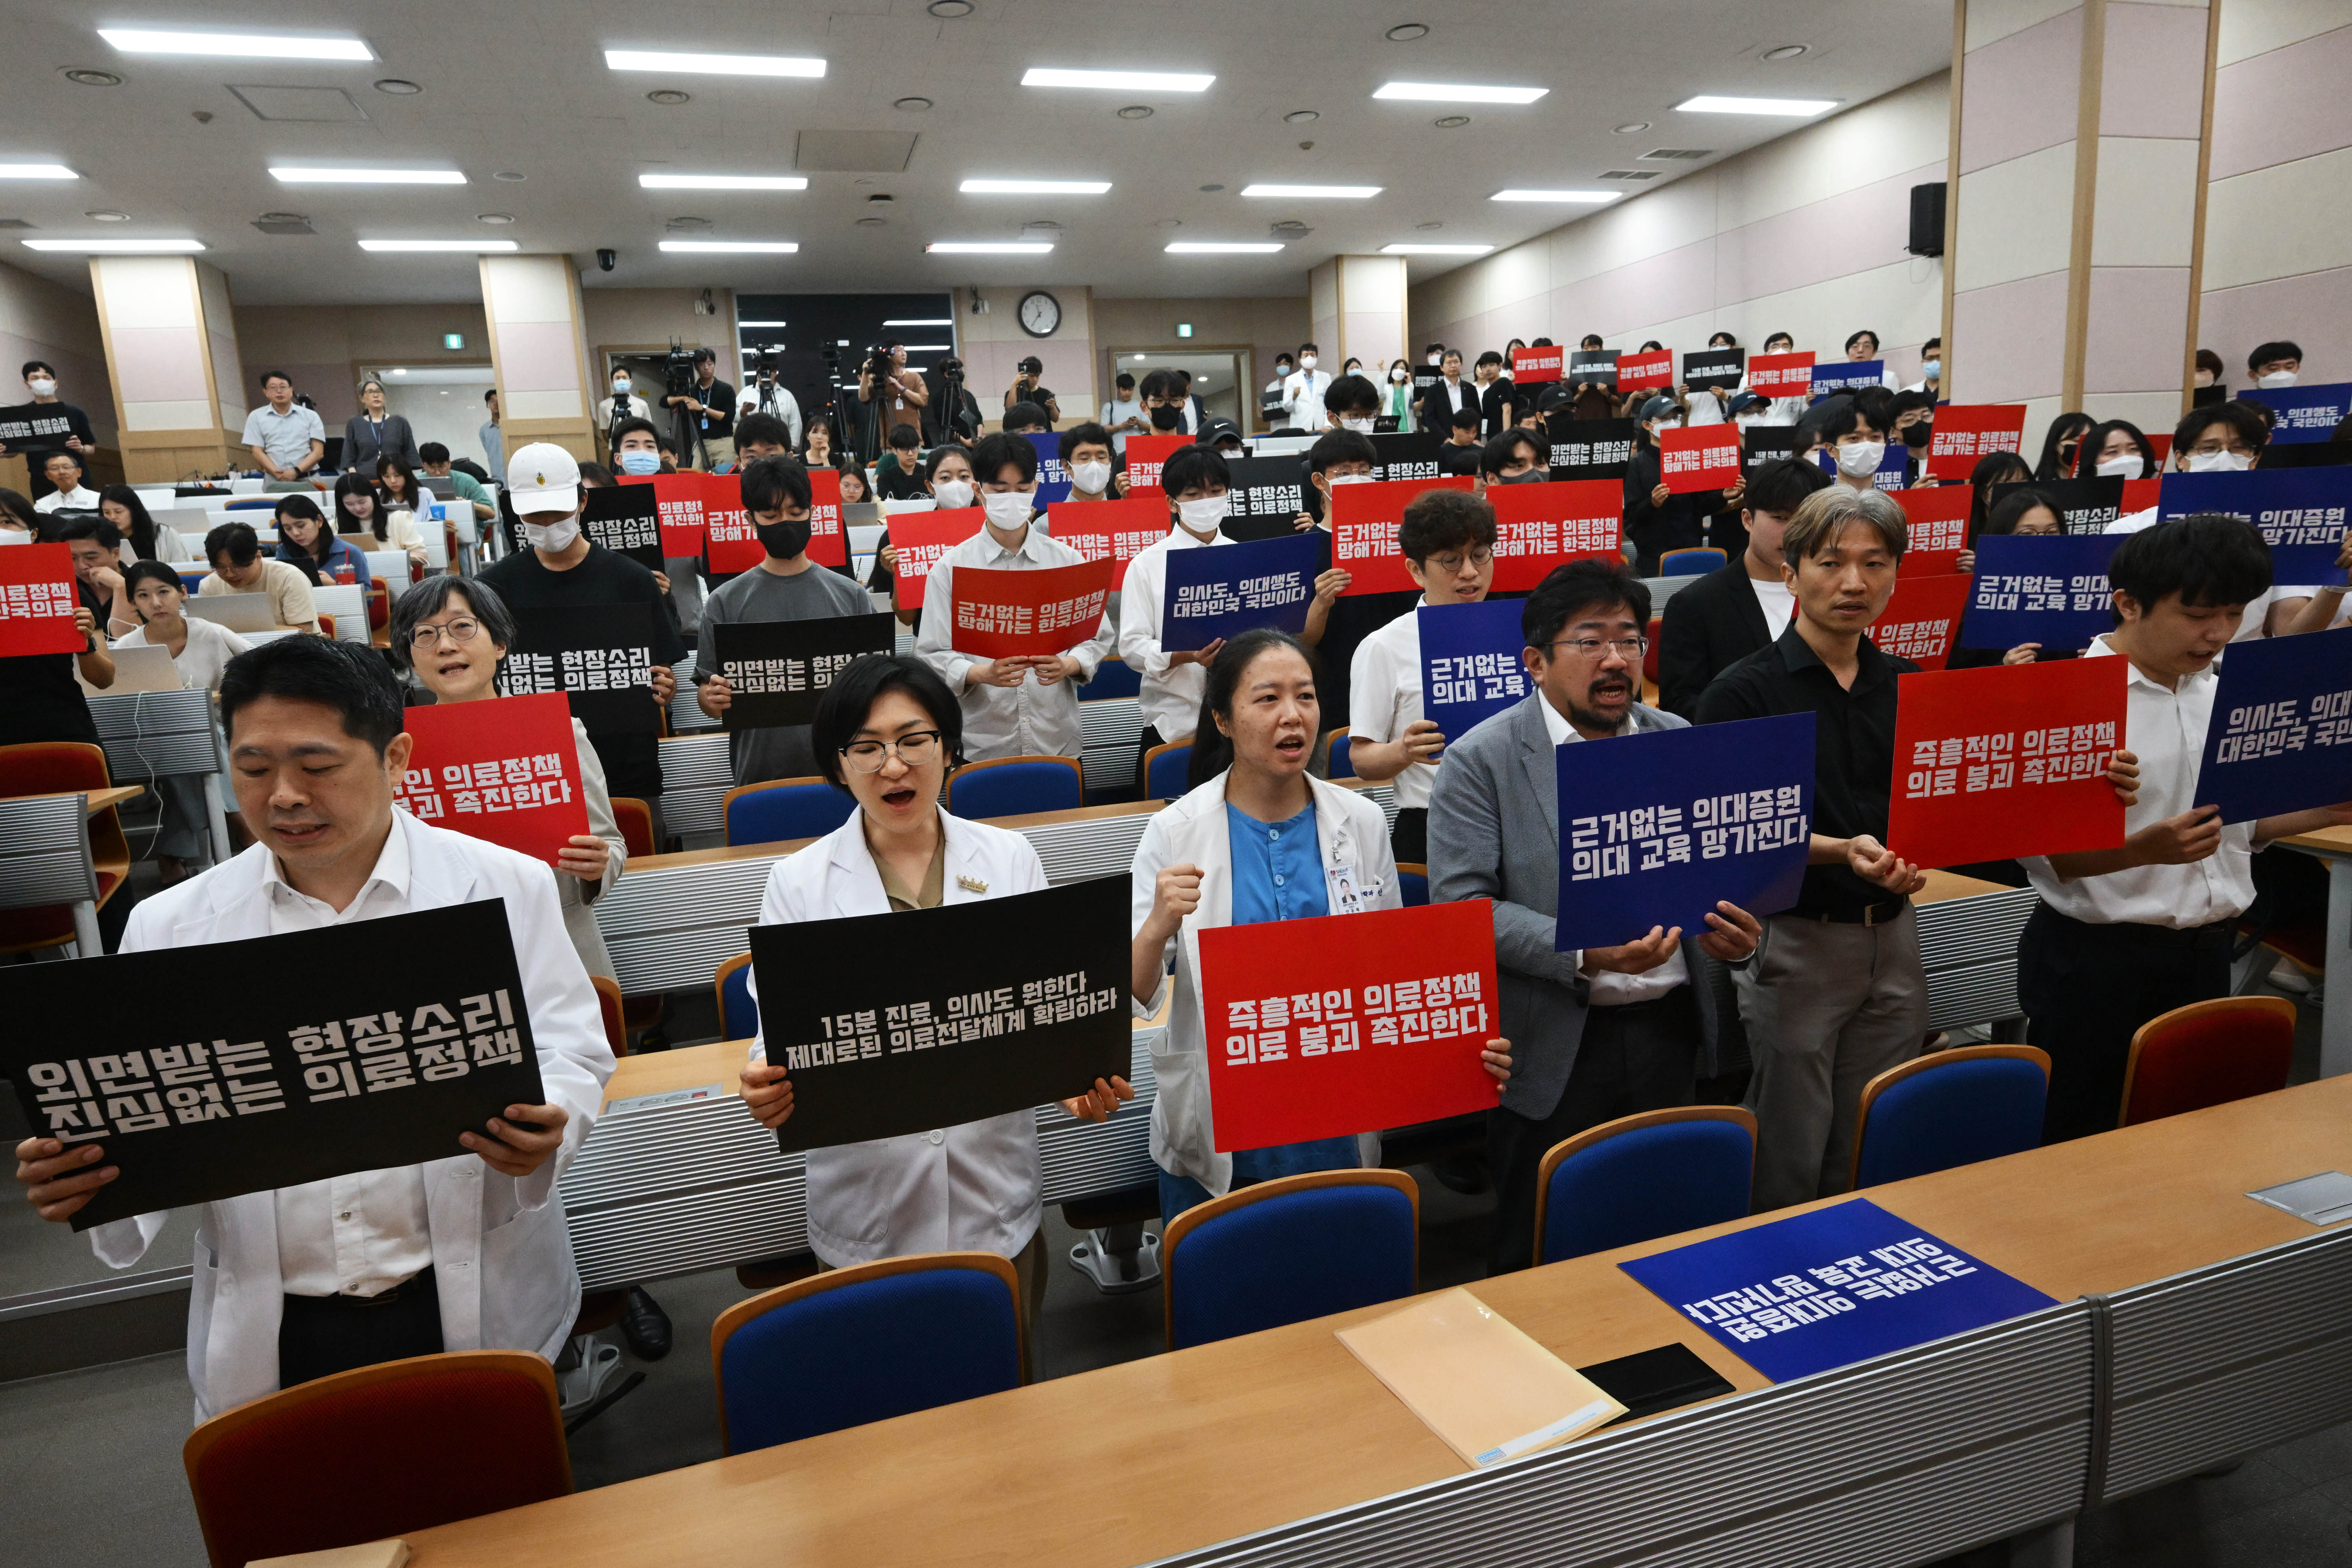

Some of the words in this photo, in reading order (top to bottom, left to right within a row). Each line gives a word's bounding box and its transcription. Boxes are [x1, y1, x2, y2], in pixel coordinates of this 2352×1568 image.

[2287, 406, 2338, 419] 의대생도
[0, 422, 30, 430] 면받는
[1934, 432, 1976, 444] 근거없는
[1979, 431, 2019, 443] 의료정책
[1549, 454, 1589, 466] 진심없는
[1592, 452, 1629, 464] 의료정책
[1551, 443, 1590, 455] 외면받는
[1593, 440, 1631, 453] 현장소리
[1663, 450, 1700, 463] 근거없는
[1703, 446, 1738, 458] 의료정책
[1932, 443, 1975, 456] 망해가는
[1388, 462, 1438, 477] 현장소리
[1663, 459, 1700, 473] 망해가는
[1703, 456, 1738, 469] 한국의료
[1873, 472, 1902, 483] 대증원
[1248, 485, 1301, 501] 현장소리
[1251, 499, 1303, 515] 의료정책
[2063, 506, 2117, 524] 현장소리
[2258, 507, 2346, 528] 의대증원
[587, 516, 656, 536] 현장소리
[662, 513, 704, 526] 촉진한
[811, 520, 838, 536] 의료
[1338, 521, 1401, 541] 근거없는
[1496, 521, 1558, 540] 근거없는
[1562, 517, 1618, 536] 의료정책
[1114, 530, 1167, 546] 의료정책
[1492, 539, 1558, 557] 망해가는
[1563, 534, 1617, 552] 한국의료
[2264, 526, 2347, 546] 망가진다
[1338, 540, 1401, 559] 망해가는
[1178, 583, 1233, 601] 의사도,
[1238, 571, 1301, 595] 의대생도
[1979, 576, 2063, 593] 근거없는
[2070, 575, 2113, 591] 의대
[958, 601, 1033, 619] 근거없는
[1039, 589, 1105, 618] 의료정책
[1174, 597, 1240, 617] 대한민국
[1245, 586, 1306, 609] 국민이다
[1976, 593, 2017, 610] 의대
[2024, 594, 2066, 611] 교육
[958, 615, 1031, 634] 망해가는
[1038, 603, 1102, 633] 한국의료
[1879, 619, 1950, 643] 의료정책
[502, 653, 553, 674] 받는
[561, 647, 650, 671] 현장소리
[723, 658, 805, 678] 외면받는
[813, 650, 890, 673] 현장
[1431, 653, 1516, 681] 근거없는
[564, 668, 652, 691] 의료정책
[729, 676, 806, 694] 진심없는
[1432, 678, 1477, 705] 의대
[1484, 673, 1524, 699] 교육
[2226, 700, 2301, 734] 의사도,
[2308, 690, 2352, 721] 의대
[1913, 731, 2014, 768] 즉흥적인
[2023, 721, 2116, 758] 의료정책
[2216, 726, 2308, 764] 대한민국
[442, 753, 563, 790] 의료정책
[1906, 768, 1957, 800] 의료
[1966, 762, 2014, 794] 붕괴
[2022, 750, 2117, 785] 촉진한다
[453, 779, 572, 814] 촉진한다
[1572, 805, 1682, 849] 근거없는
[1692, 785, 1801, 830] 의대증원
[1572, 844, 1629, 881] 의대
[1641, 833, 1690, 871] 교육
[1702, 815, 1808, 860] 망가진다
[821, 1011, 877, 1039] 15분
[886, 1002, 939, 1030] 진료,
[948, 987, 1014, 1019] 의사도
[1023, 971, 1087, 1007] 원한다
[1228, 988, 1352, 1029] 즉흥적인
[1364, 972, 1481, 1017] 의료정책
[786, 1034, 882, 1070] 제대로된
[890, 1008, 1025, 1055] 의료전달체계
[1034, 987, 1117, 1027] 확립하라
[1227, 1030, 1288, 1065] 의료
[1299, 1021, 1360, 1057] 붕괴
[1371, 1003, 1488, 1046] 촉진한다
[28, 1039, 270, 1102] 외면받는
[288, 989, 514, 1065] 현장소리
[42, 1081, 286, 1144] 진심없는
[303, 1028, 523, 1104] 의료정책
[1869, 1237, 1943, 1268] 의대
[1807, 1255, 1883, 1286] 교육
[1847, 1254, 1978, 1300] 근거없는
[1682, 1275, 1820, 1323] 망가진다
[1718, 1290, 1856, 1343] 의대증원
